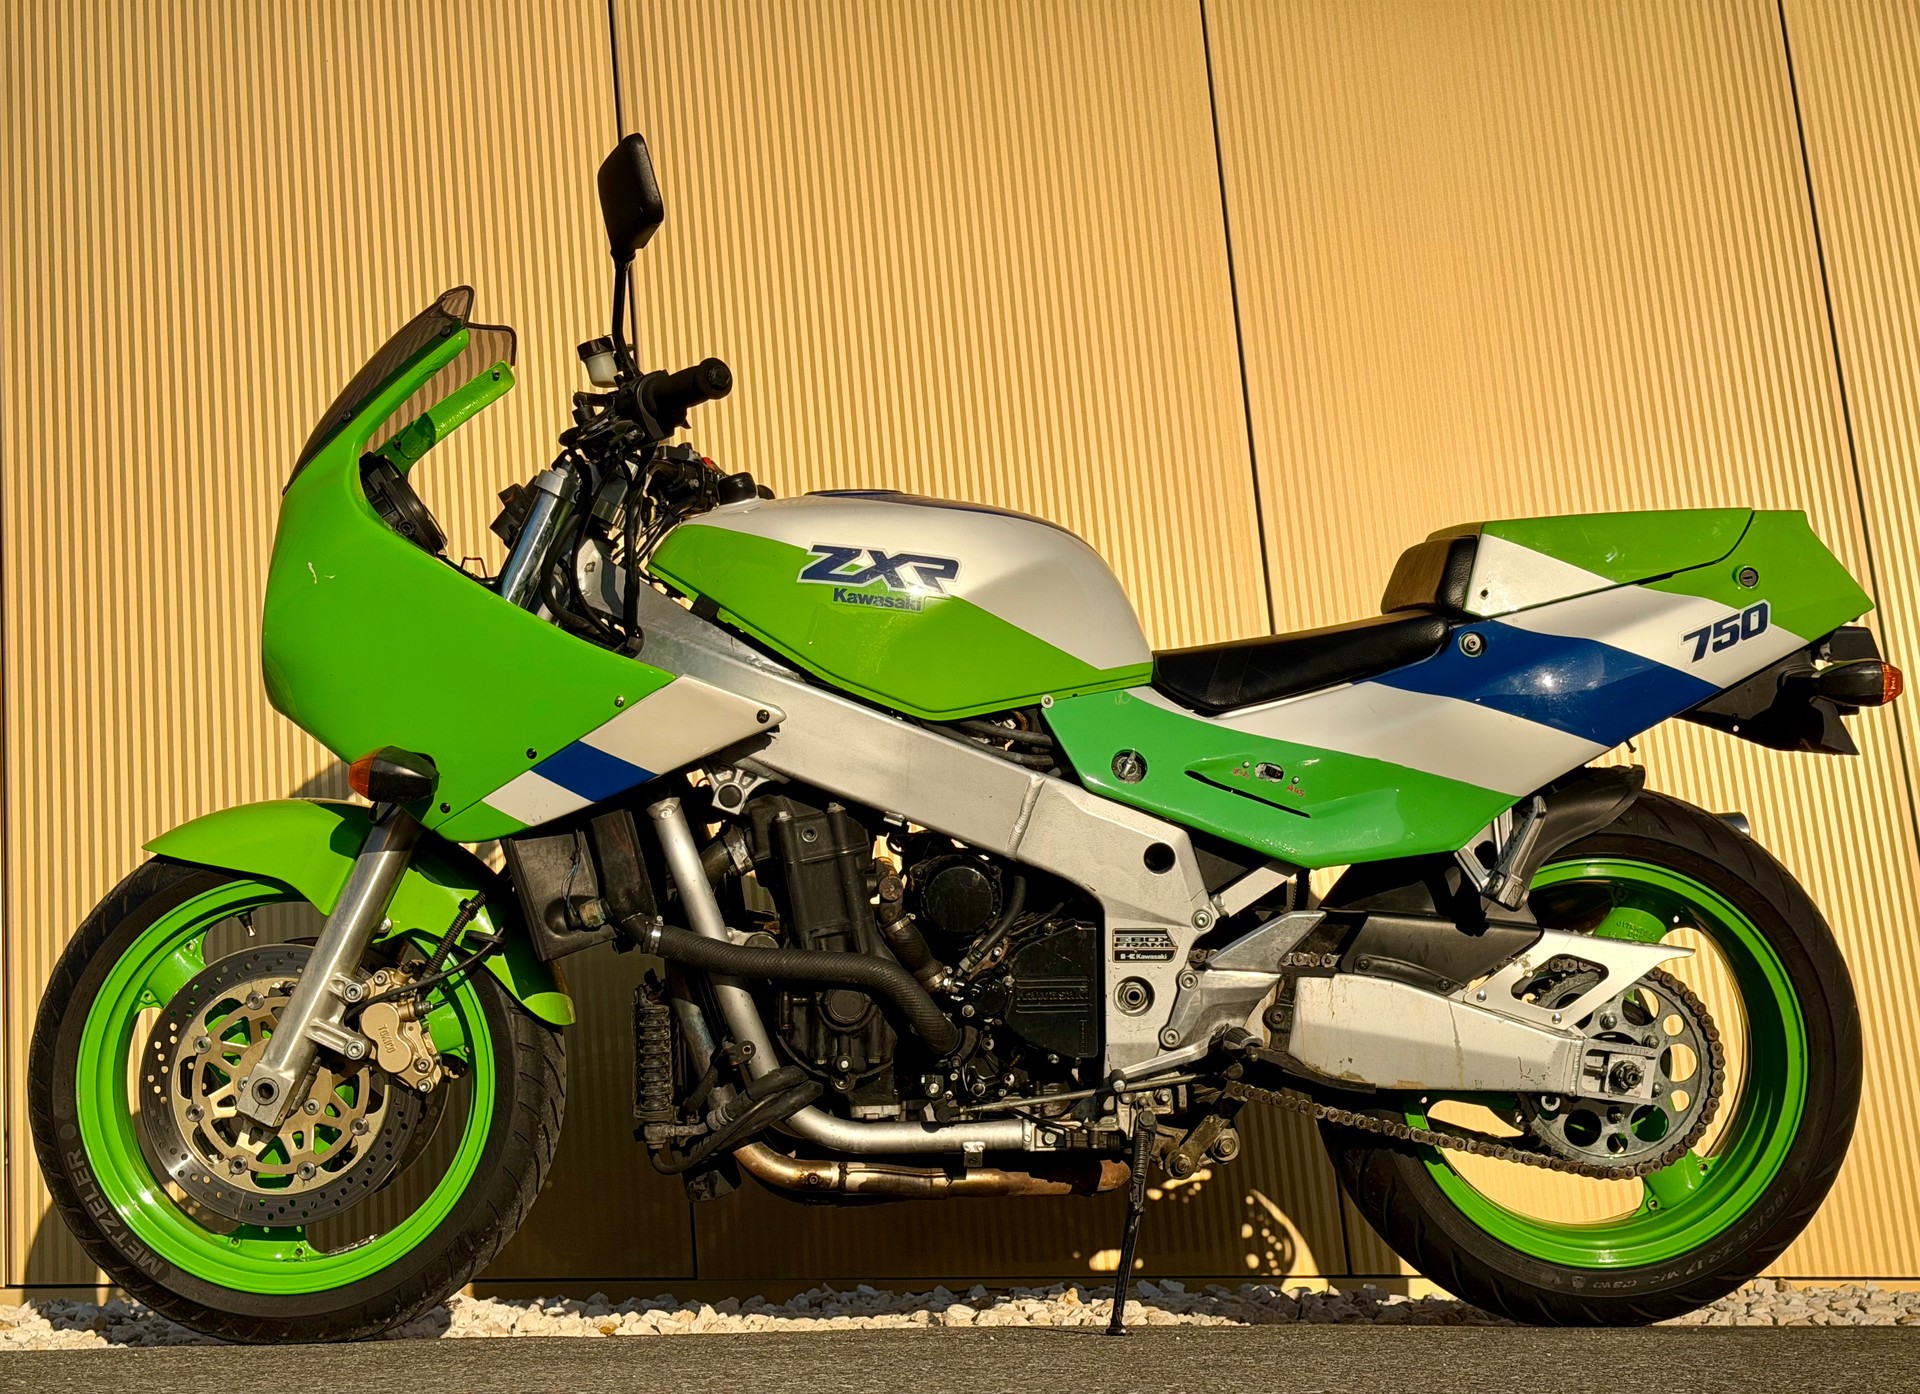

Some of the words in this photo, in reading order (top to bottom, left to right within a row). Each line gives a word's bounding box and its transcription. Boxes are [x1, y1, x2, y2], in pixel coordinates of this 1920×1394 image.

[800, 544, 960, 595] ZXR
[833, 588, 922, 612] Kawasaki
[1683, 602, 1768, 663] 750
[378, 1025, 396, 1054] TOKICO
[66, 1149, 164, 1276] METZELER
[1686, 1259, 1703, 1275] 17
